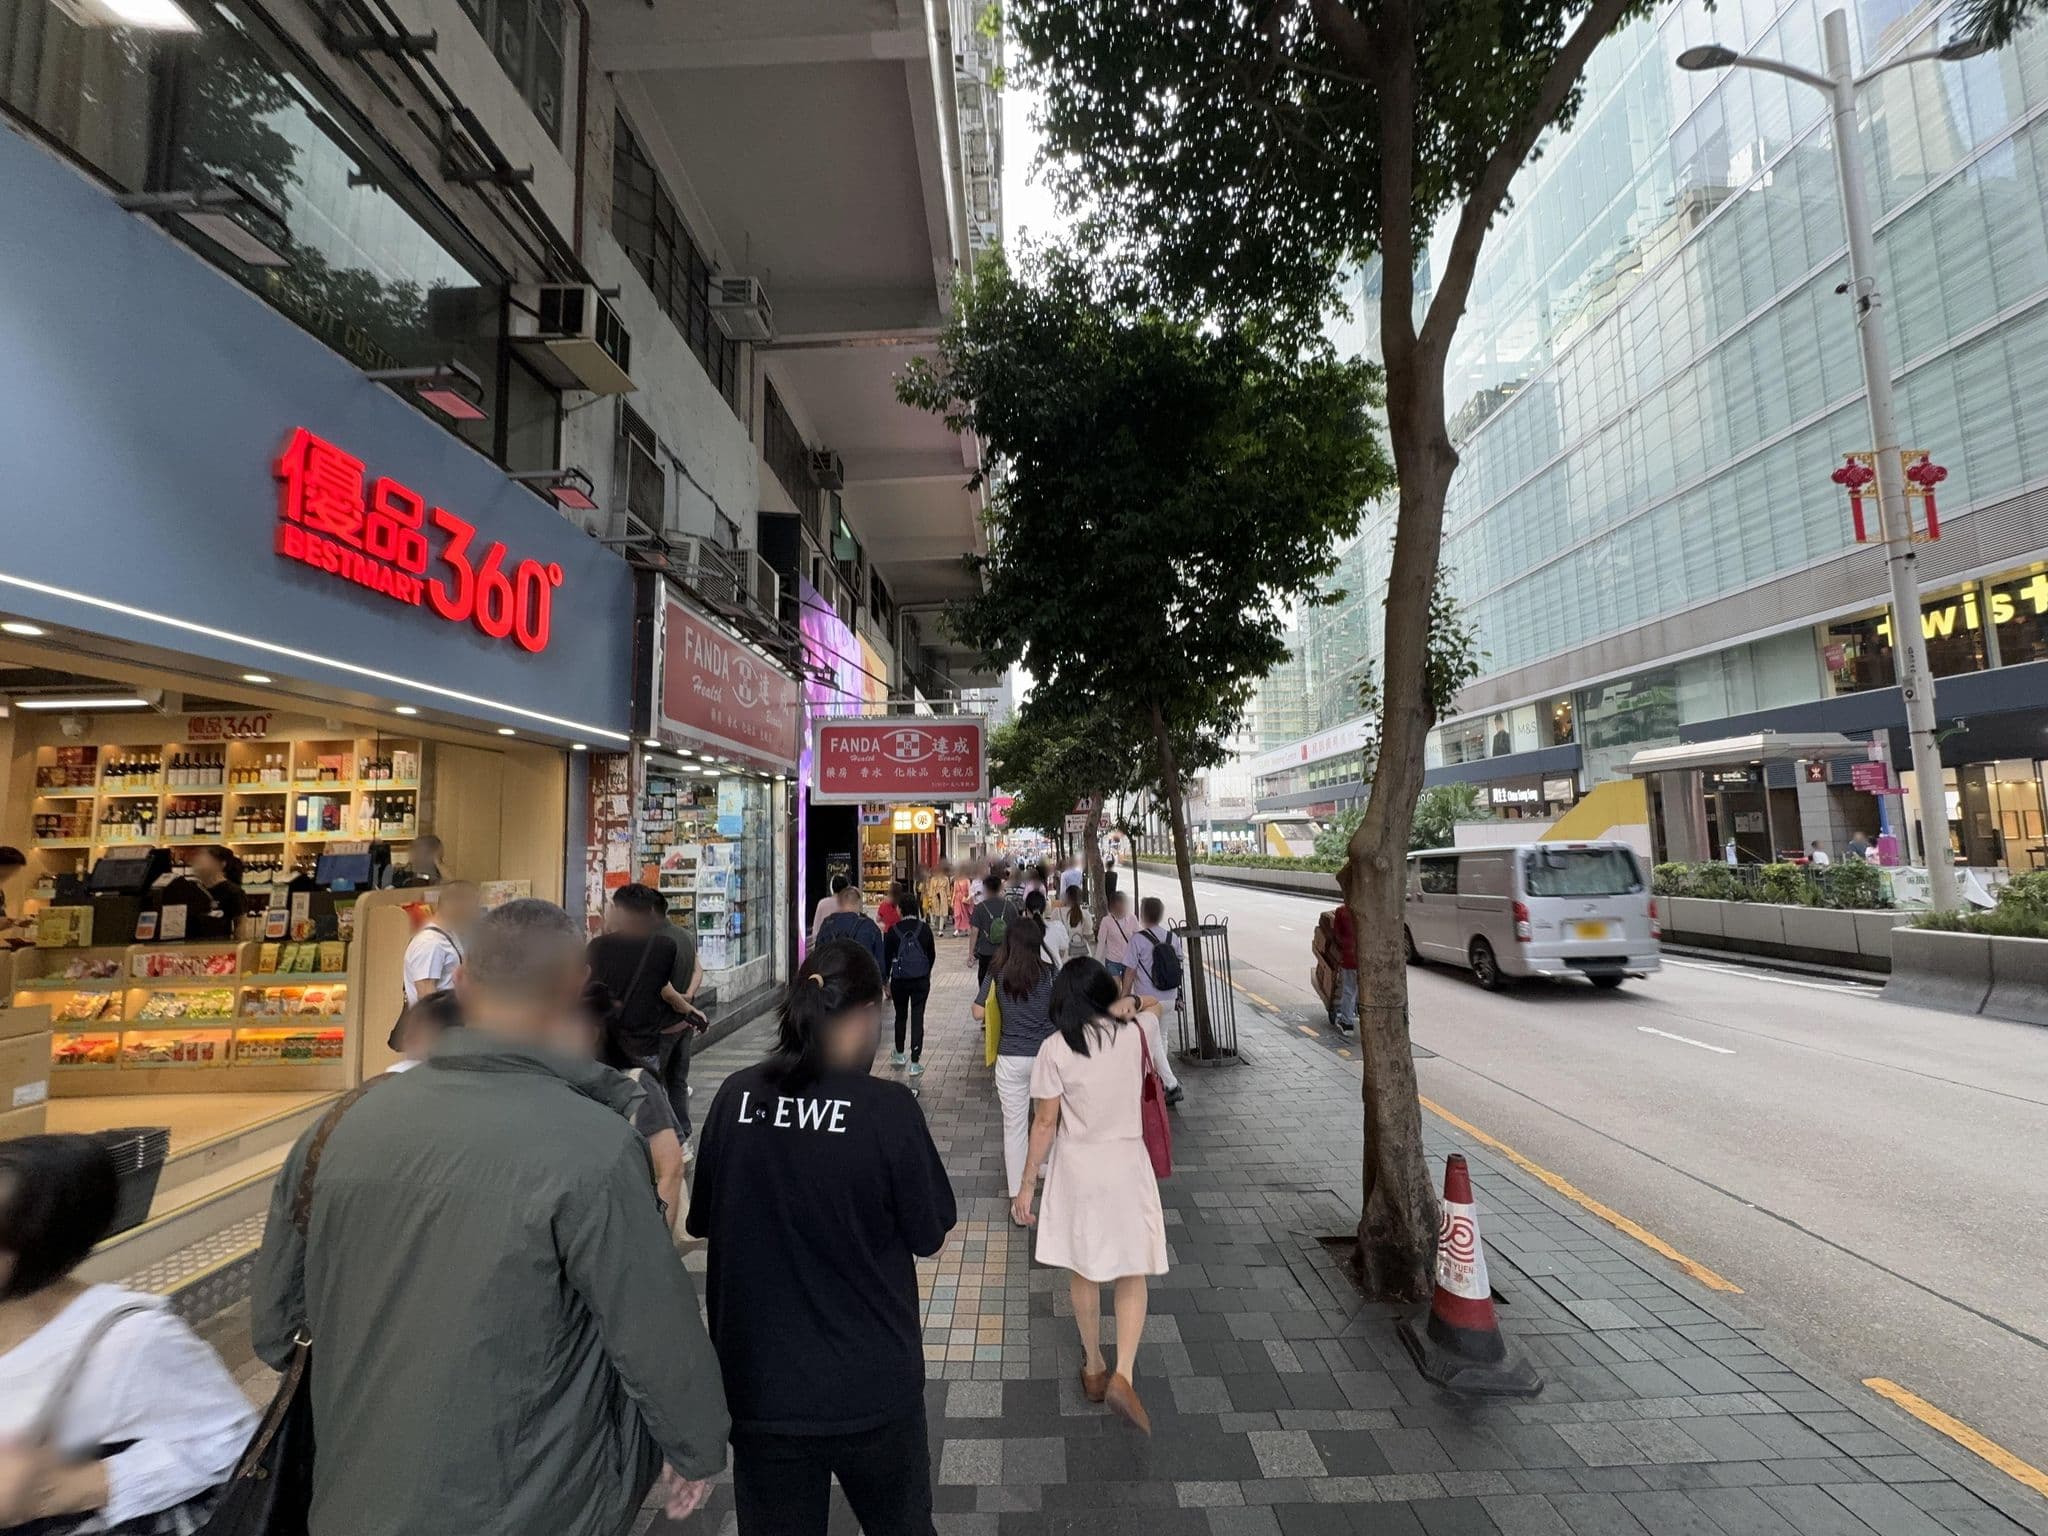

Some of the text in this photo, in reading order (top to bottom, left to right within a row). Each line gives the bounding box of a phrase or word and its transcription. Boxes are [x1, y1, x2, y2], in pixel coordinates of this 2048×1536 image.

[281, 521, 425, 607] BESTMART
[684, 625, 730, 682] FANDA
[691, 674, 723, 703] Health
[1517, 720, 1537, 734] M&S
[830, 737, 881, 753] FANDA
[932, 736, 970, 755] 達成
[850, 754, 876, 763] Health
[859, 767, 883, 779] 香水
[738, 1091, 851, 1133] LEWE
[1453, 1263, 1474, 1275] YUEN
